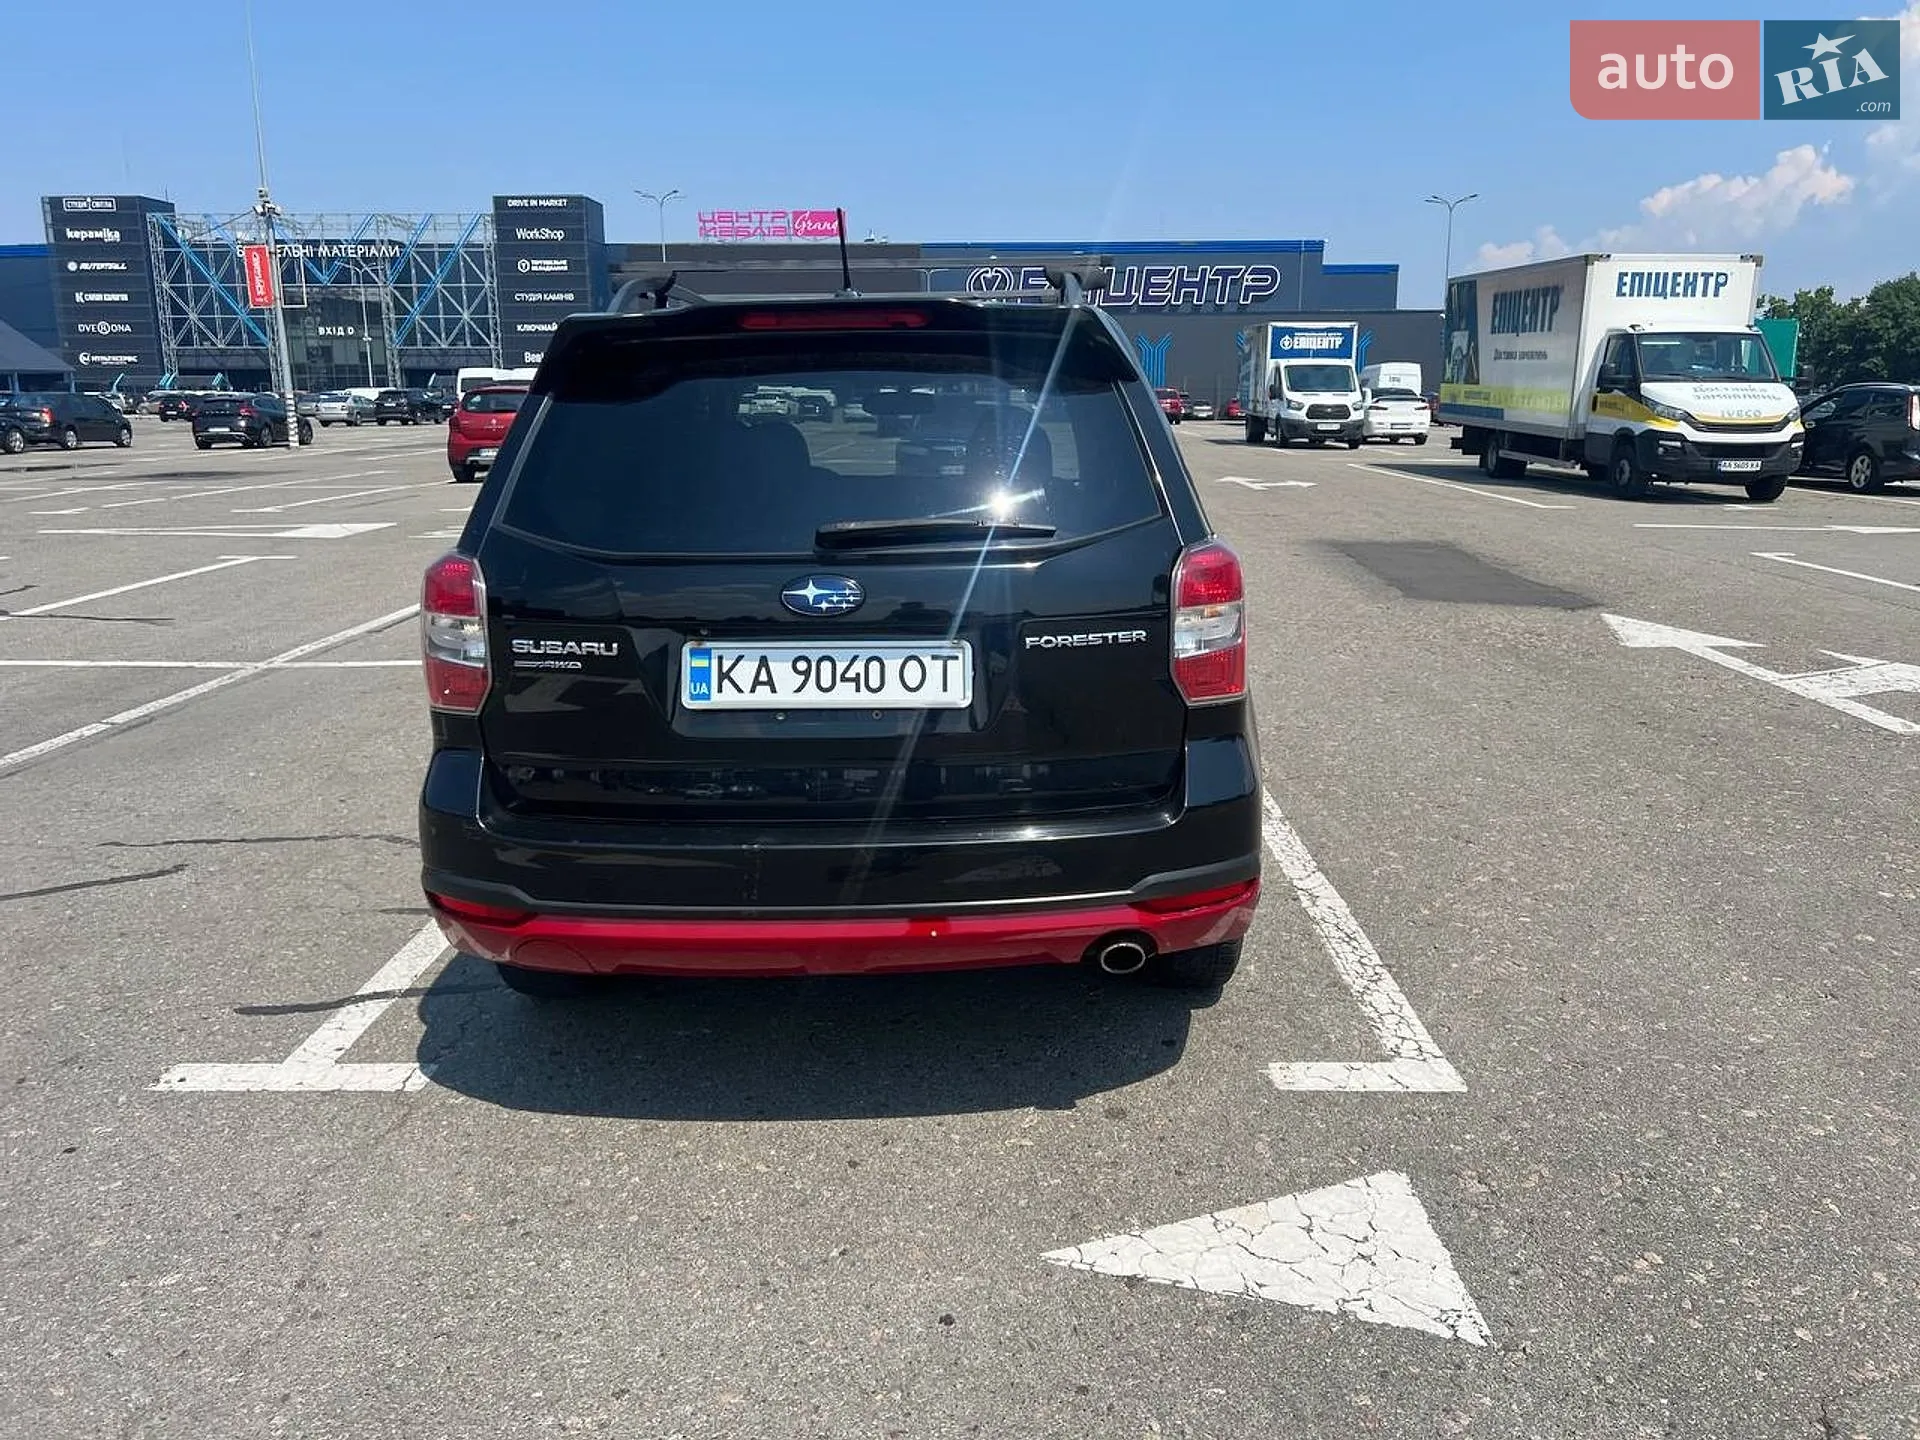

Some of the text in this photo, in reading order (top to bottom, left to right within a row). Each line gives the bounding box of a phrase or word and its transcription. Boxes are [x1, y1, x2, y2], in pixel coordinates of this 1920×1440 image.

[507, 199, 529, 207] DRIVE
[539, 199, 568, 207] MARKET
[515, 228, 565, 241] WorkShop
[318, 244, 400, 258] МАТЕРІАЛИ
[1615, 272, 1729, 300] ЕПІЦЕНТР
[514, 292, 575, 302] СТУДІЯ КАМІНІВ
[1490, 286, 1560, 337] ЕПІЦЕНТР
[318, 326, 345, 336] ВХІД
[1720, 409, 1763, 418] IVECO
[1024, 629, 1147, 650] FORESTER
[511, 638, 618, 657] SUBARU
[716, 654, 960, 694] KA 9040 OT
[690, 682, 709, 695] UA
